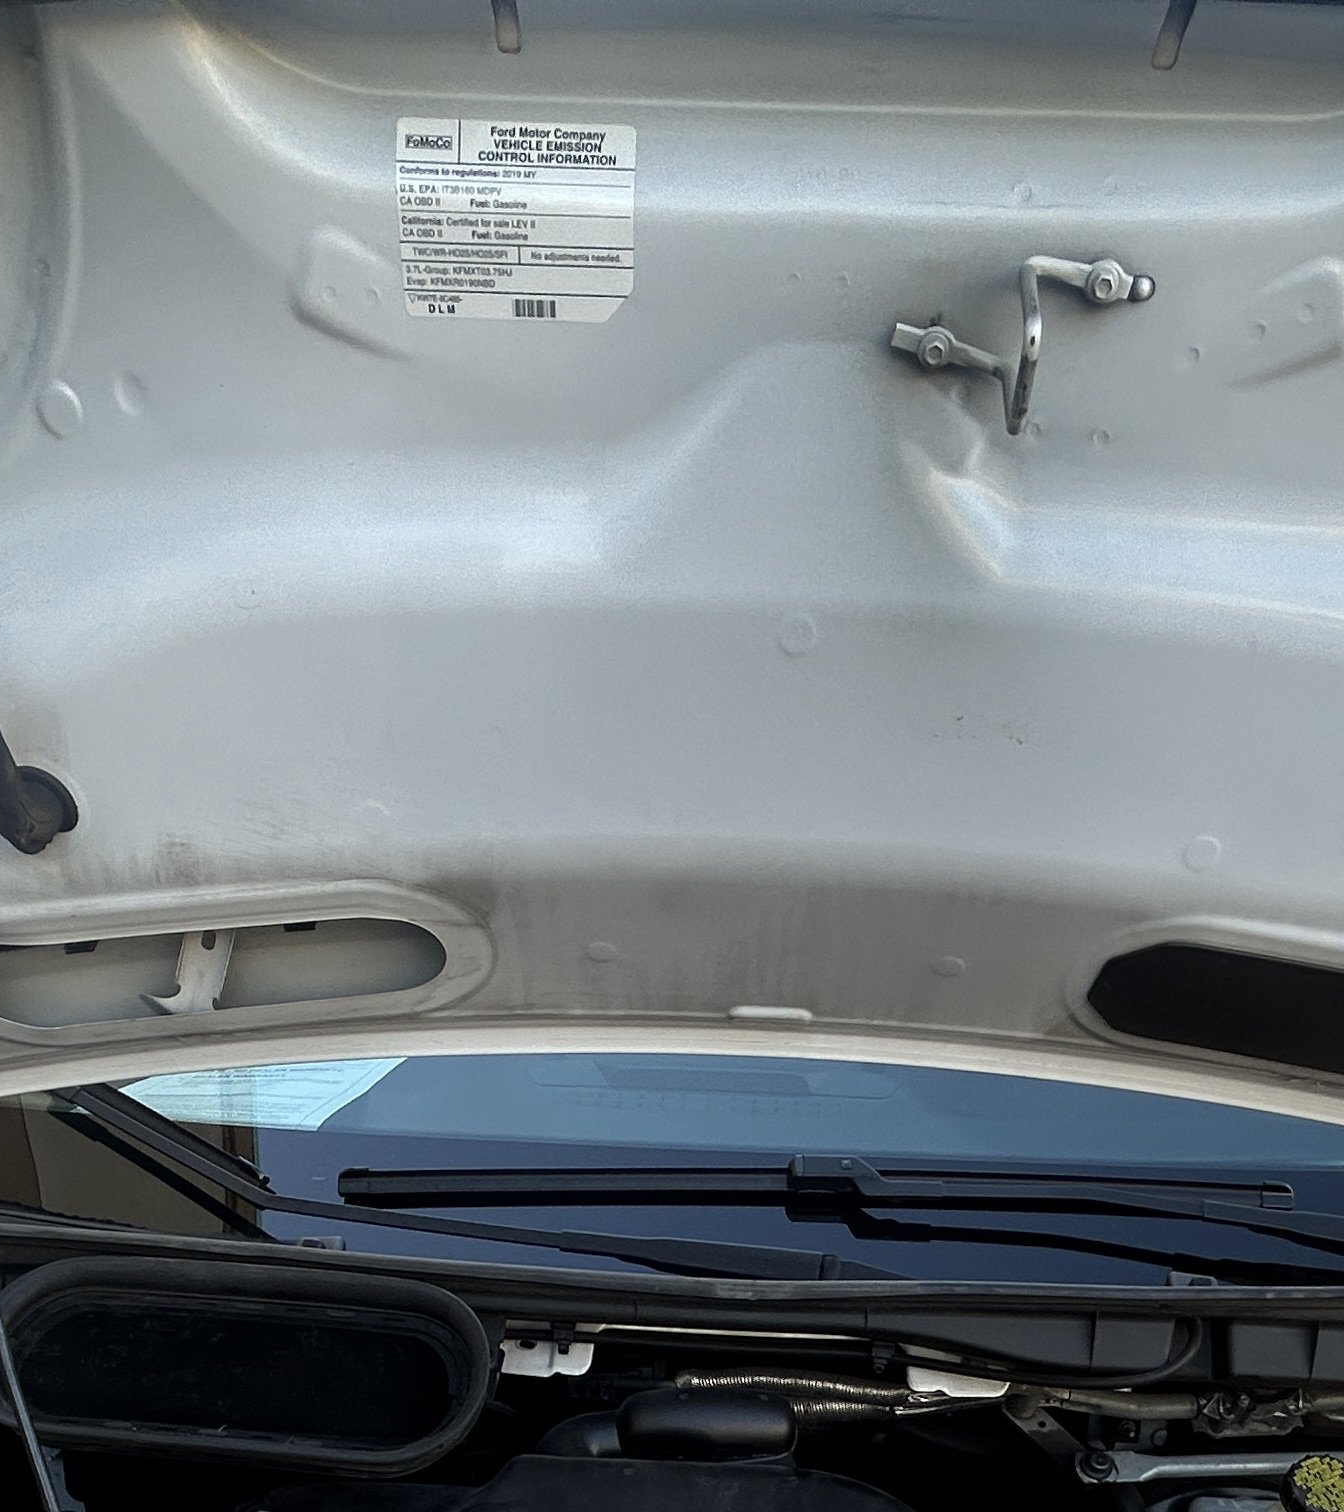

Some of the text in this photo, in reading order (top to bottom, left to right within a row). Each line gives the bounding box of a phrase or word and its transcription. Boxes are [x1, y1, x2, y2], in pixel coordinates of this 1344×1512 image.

[490, 126, 607, 142] Ford Motor Company
[406, 135, 452, 149] FoMoCo
[494, 139, 602, 153] VEHICLE EMISSION
[478, 151, 617, 166] CONTROL INFORMATION
[399, 165, 439, 176] Conforms
[441, 168, 450, 176] to
[399, 196, 412, 206] CA
[511, 220, 528, 229] LEV
[402, 228, 415, 237] CA
[531, 251, 542, 260] No
